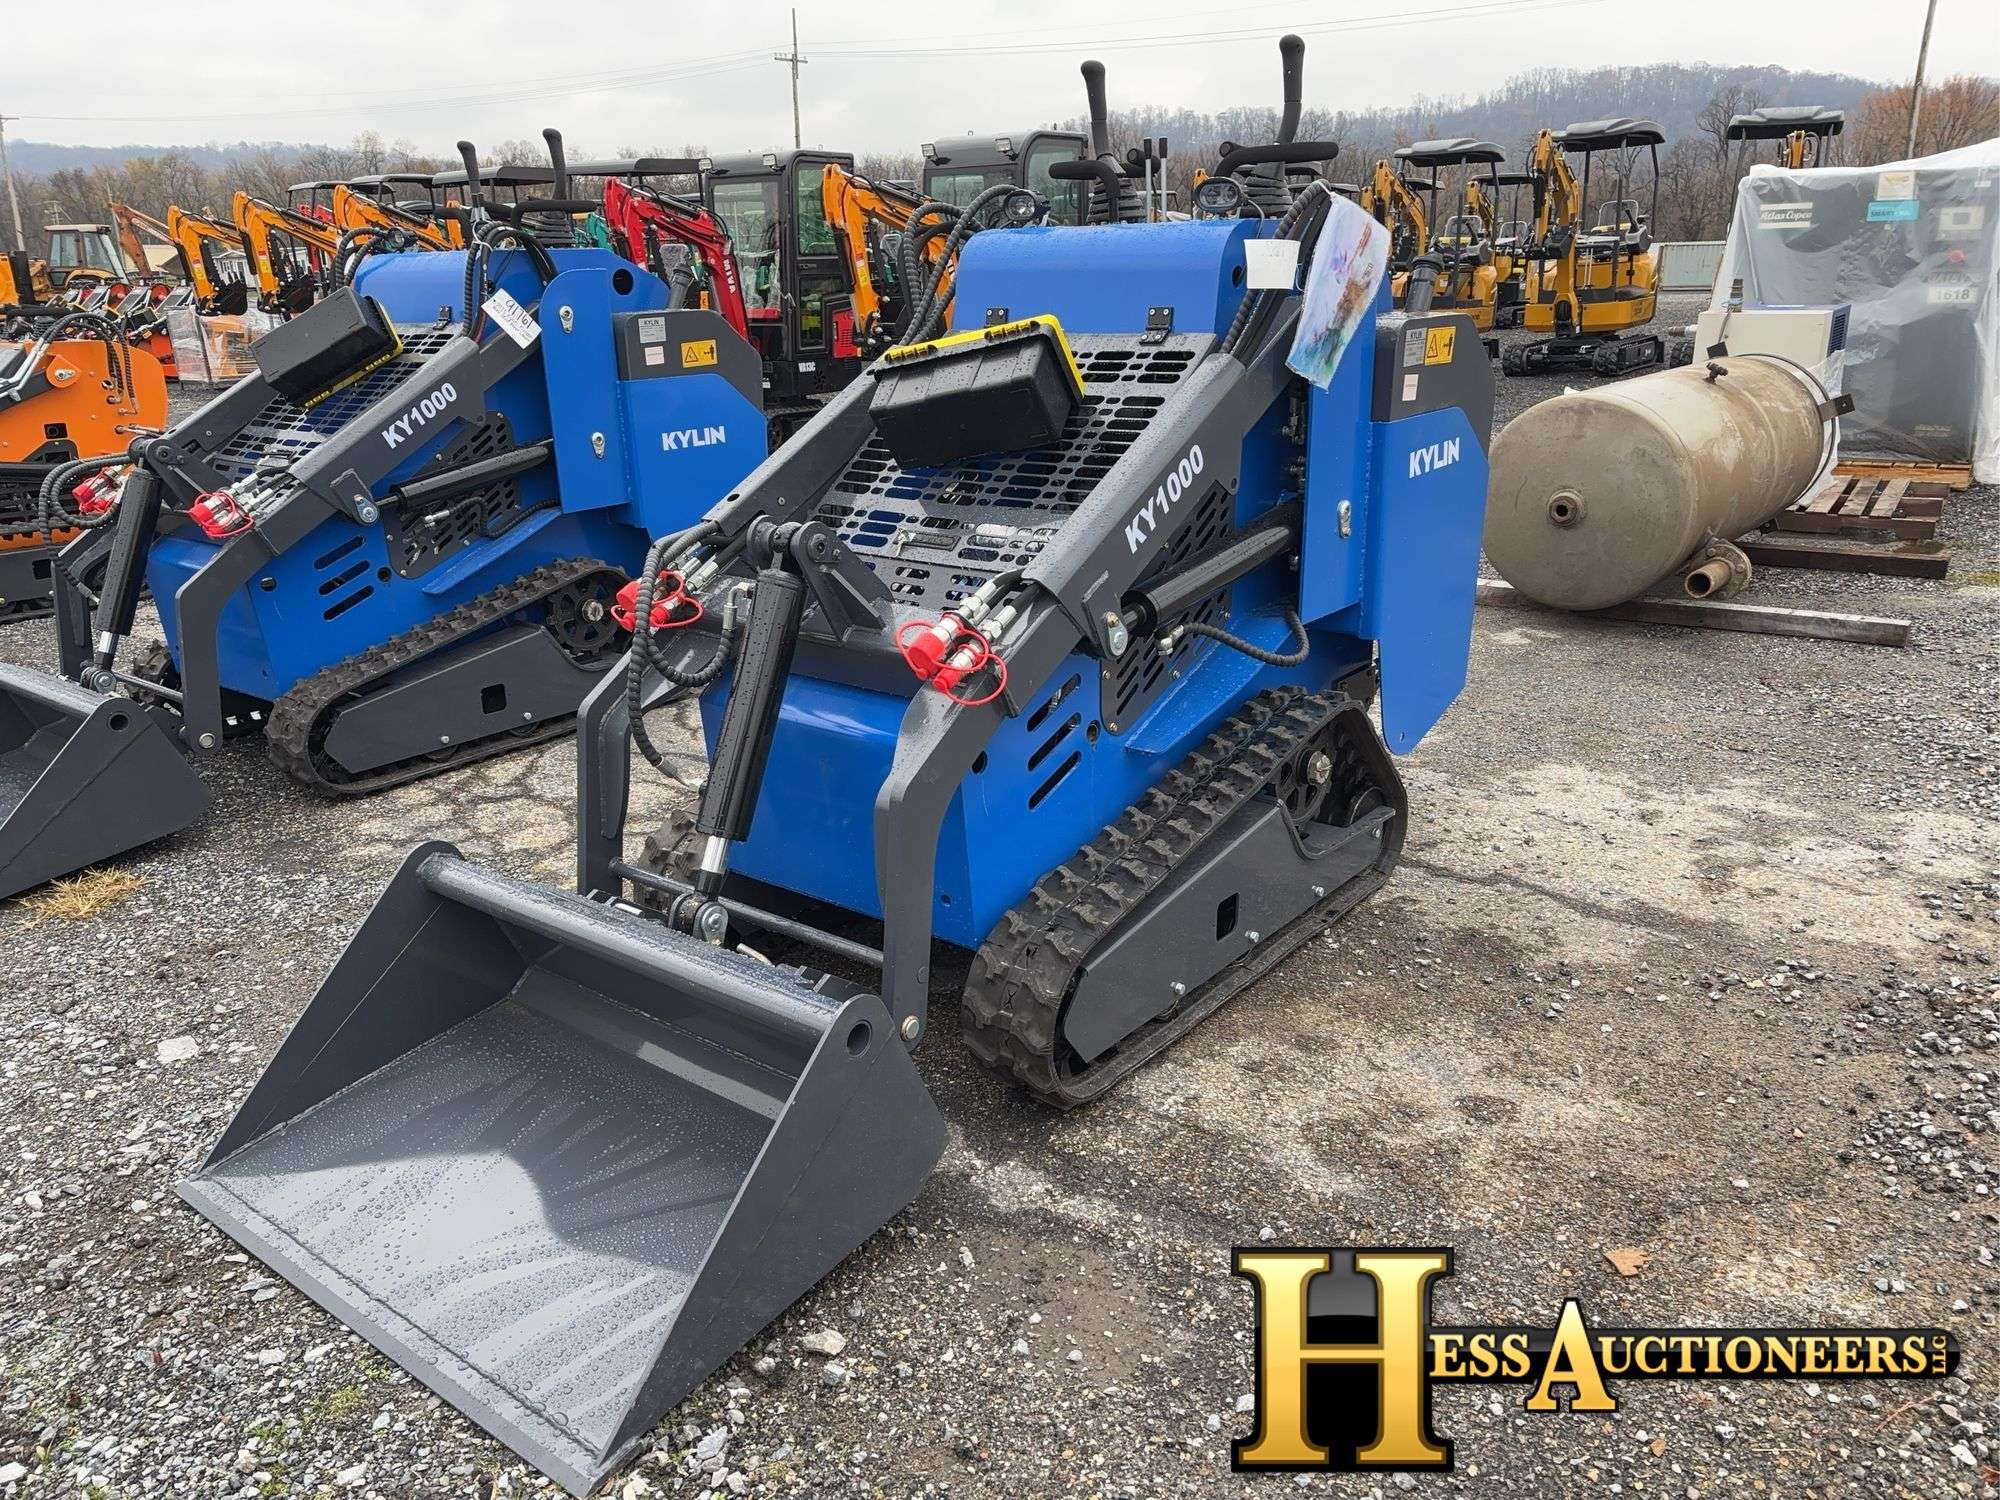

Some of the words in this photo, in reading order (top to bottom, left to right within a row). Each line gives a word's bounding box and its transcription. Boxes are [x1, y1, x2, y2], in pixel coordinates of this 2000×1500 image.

[1760, 210, 1786, 220] Atlas
[382, 383, 457, 449] KY1000
[662, 426, 726, 451] KYLIN
[1409, 437, 1460, 479] KYLIN
[1124, 444, 1204, 555] KY1000
